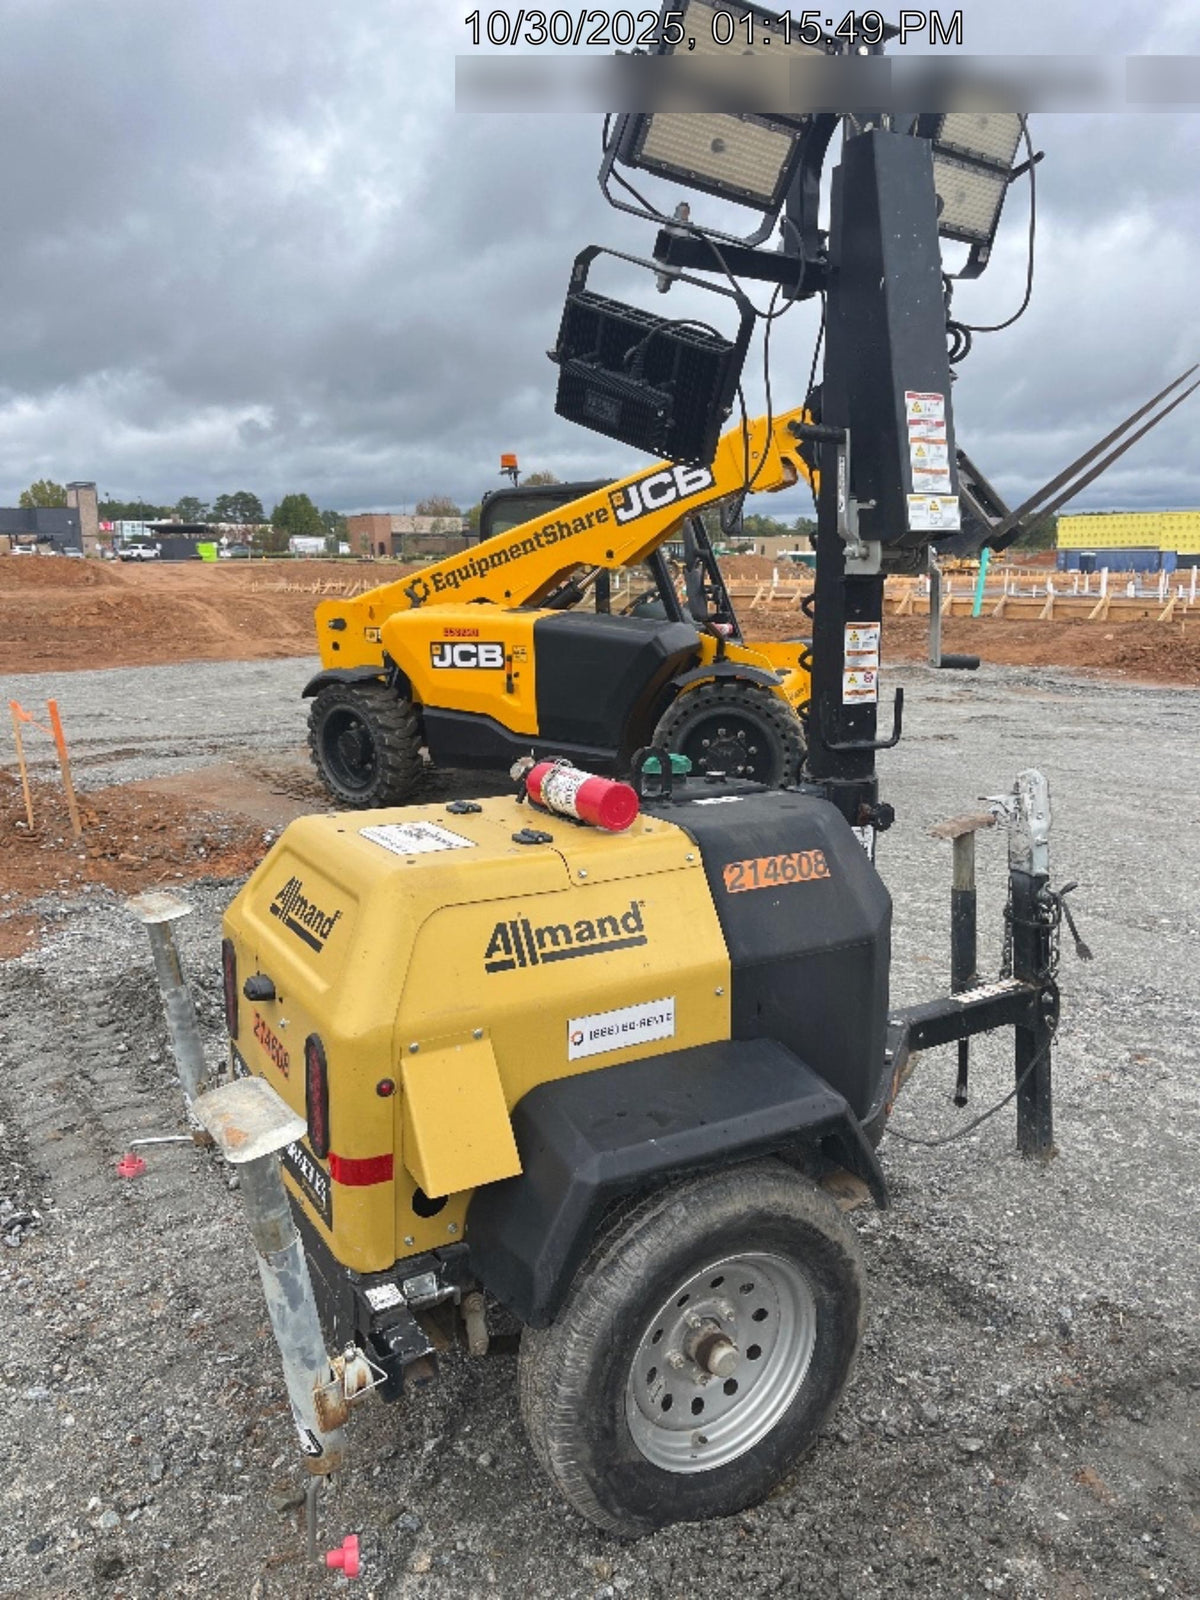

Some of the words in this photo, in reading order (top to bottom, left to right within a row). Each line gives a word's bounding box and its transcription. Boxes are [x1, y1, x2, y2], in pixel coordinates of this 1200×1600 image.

[617, 465, 712, 522] JCB
[430, 506, 609, 592] EquipmentShare
[433, 644, 504, 668] JCB
[729, 850, 828, 890] 214608
[272, 876, 340, 945] Allmand
[485, 901, 646, 971] Allmand
